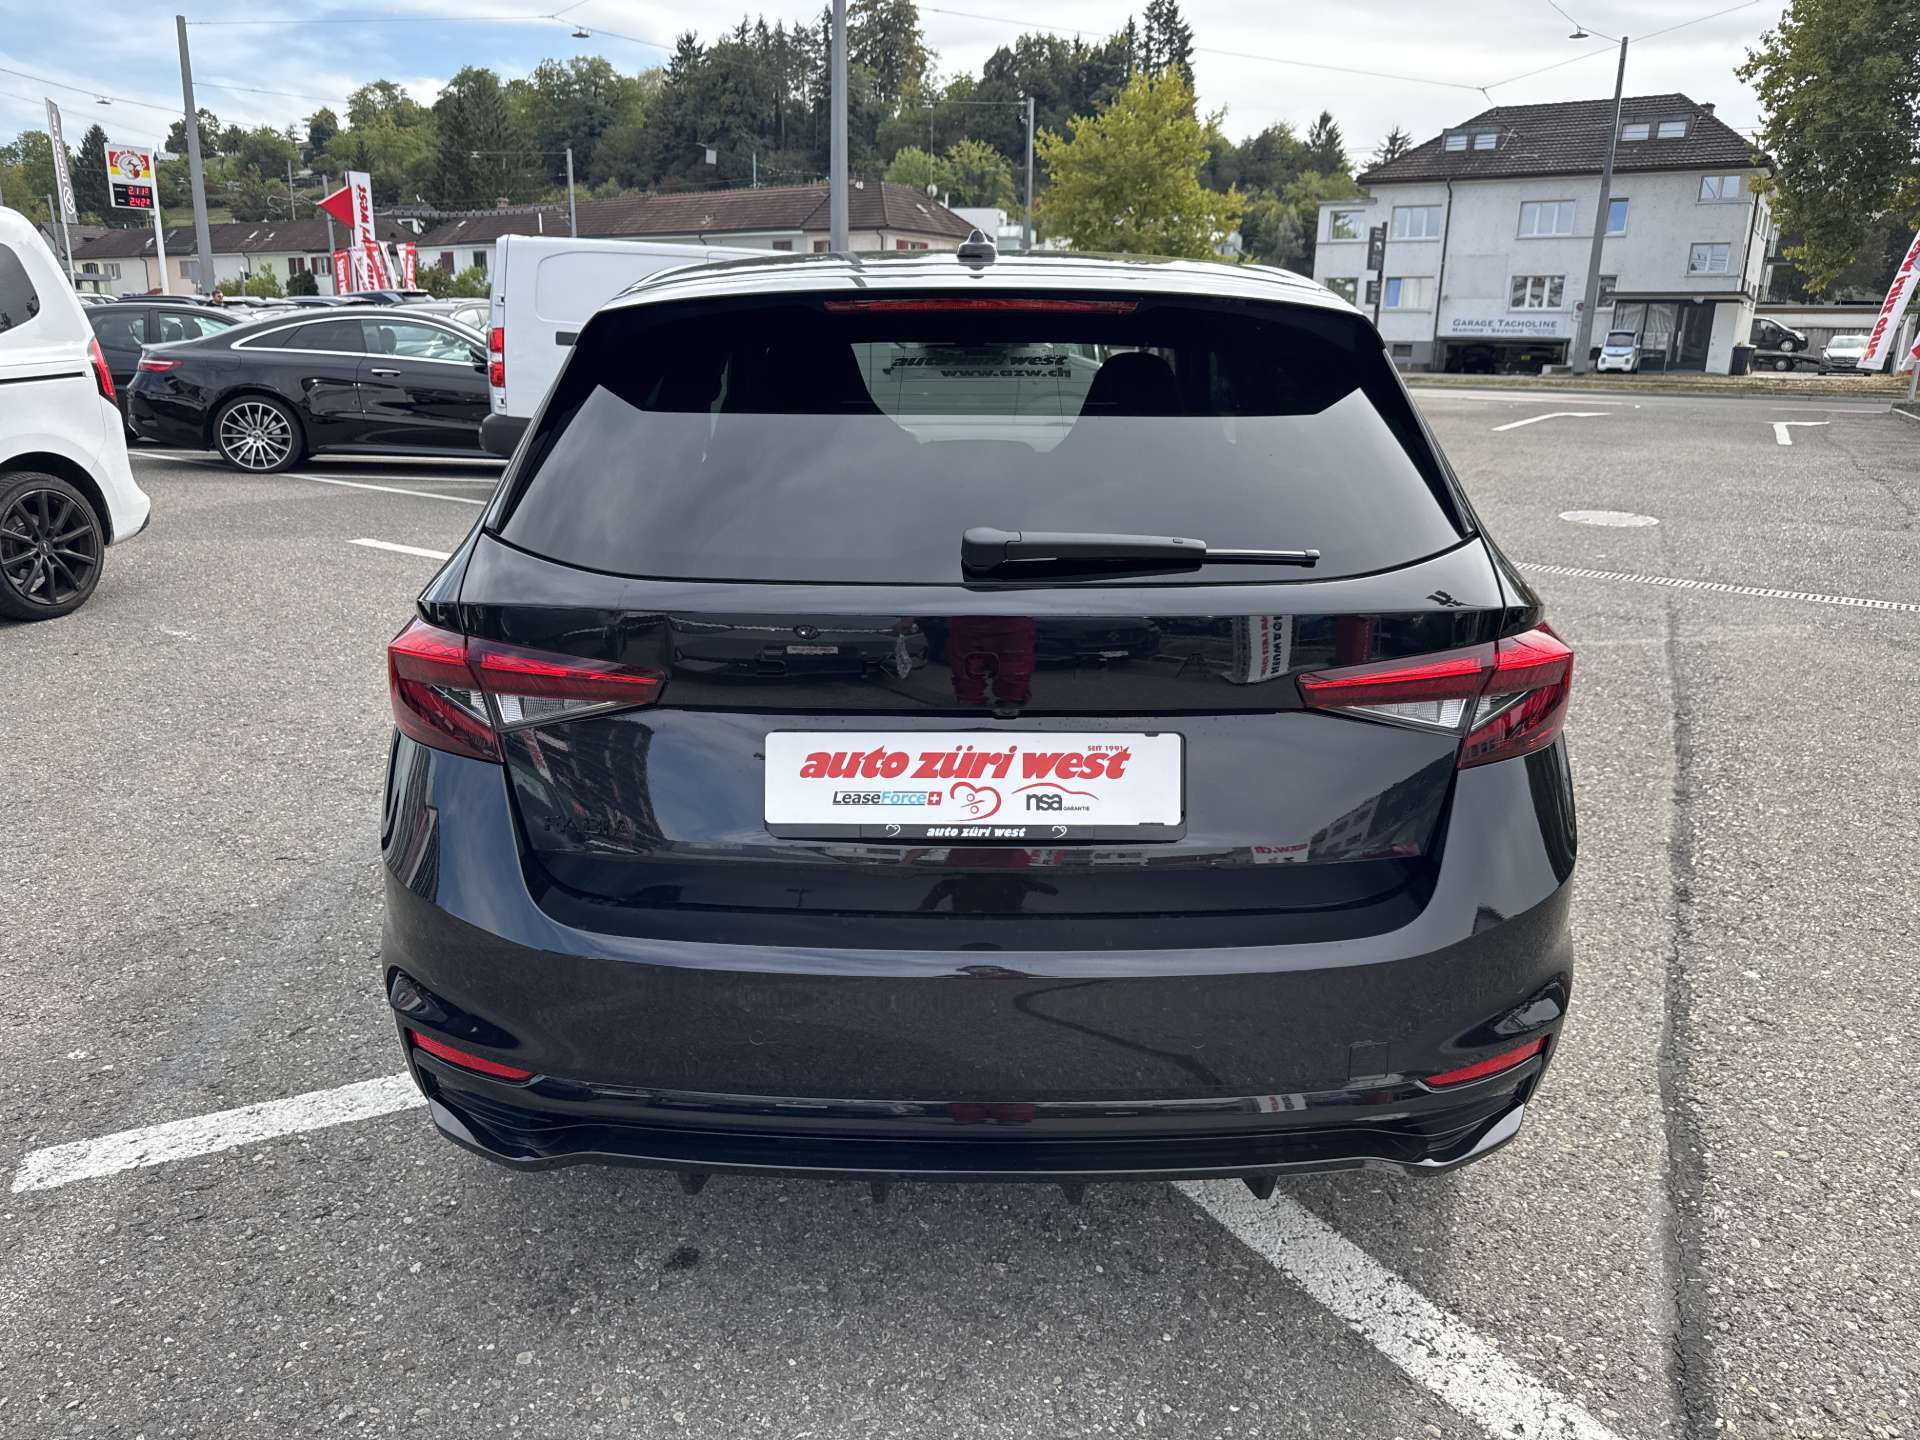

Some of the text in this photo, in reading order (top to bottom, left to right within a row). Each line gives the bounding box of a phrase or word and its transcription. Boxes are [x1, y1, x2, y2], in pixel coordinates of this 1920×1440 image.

[358, 184, 369, 224] west
[1453, 319, 1557, 328] GARAGE TACHOLINE
[940, 367, 1071, 378] www.azw.ch
[800, 745, 1131, 780] auto züri west
[832, 791, 927, 804] LeaseForce
[1026, 793, 1062, 811] nsa
[927, 827, 1026, 837] auto züri west
